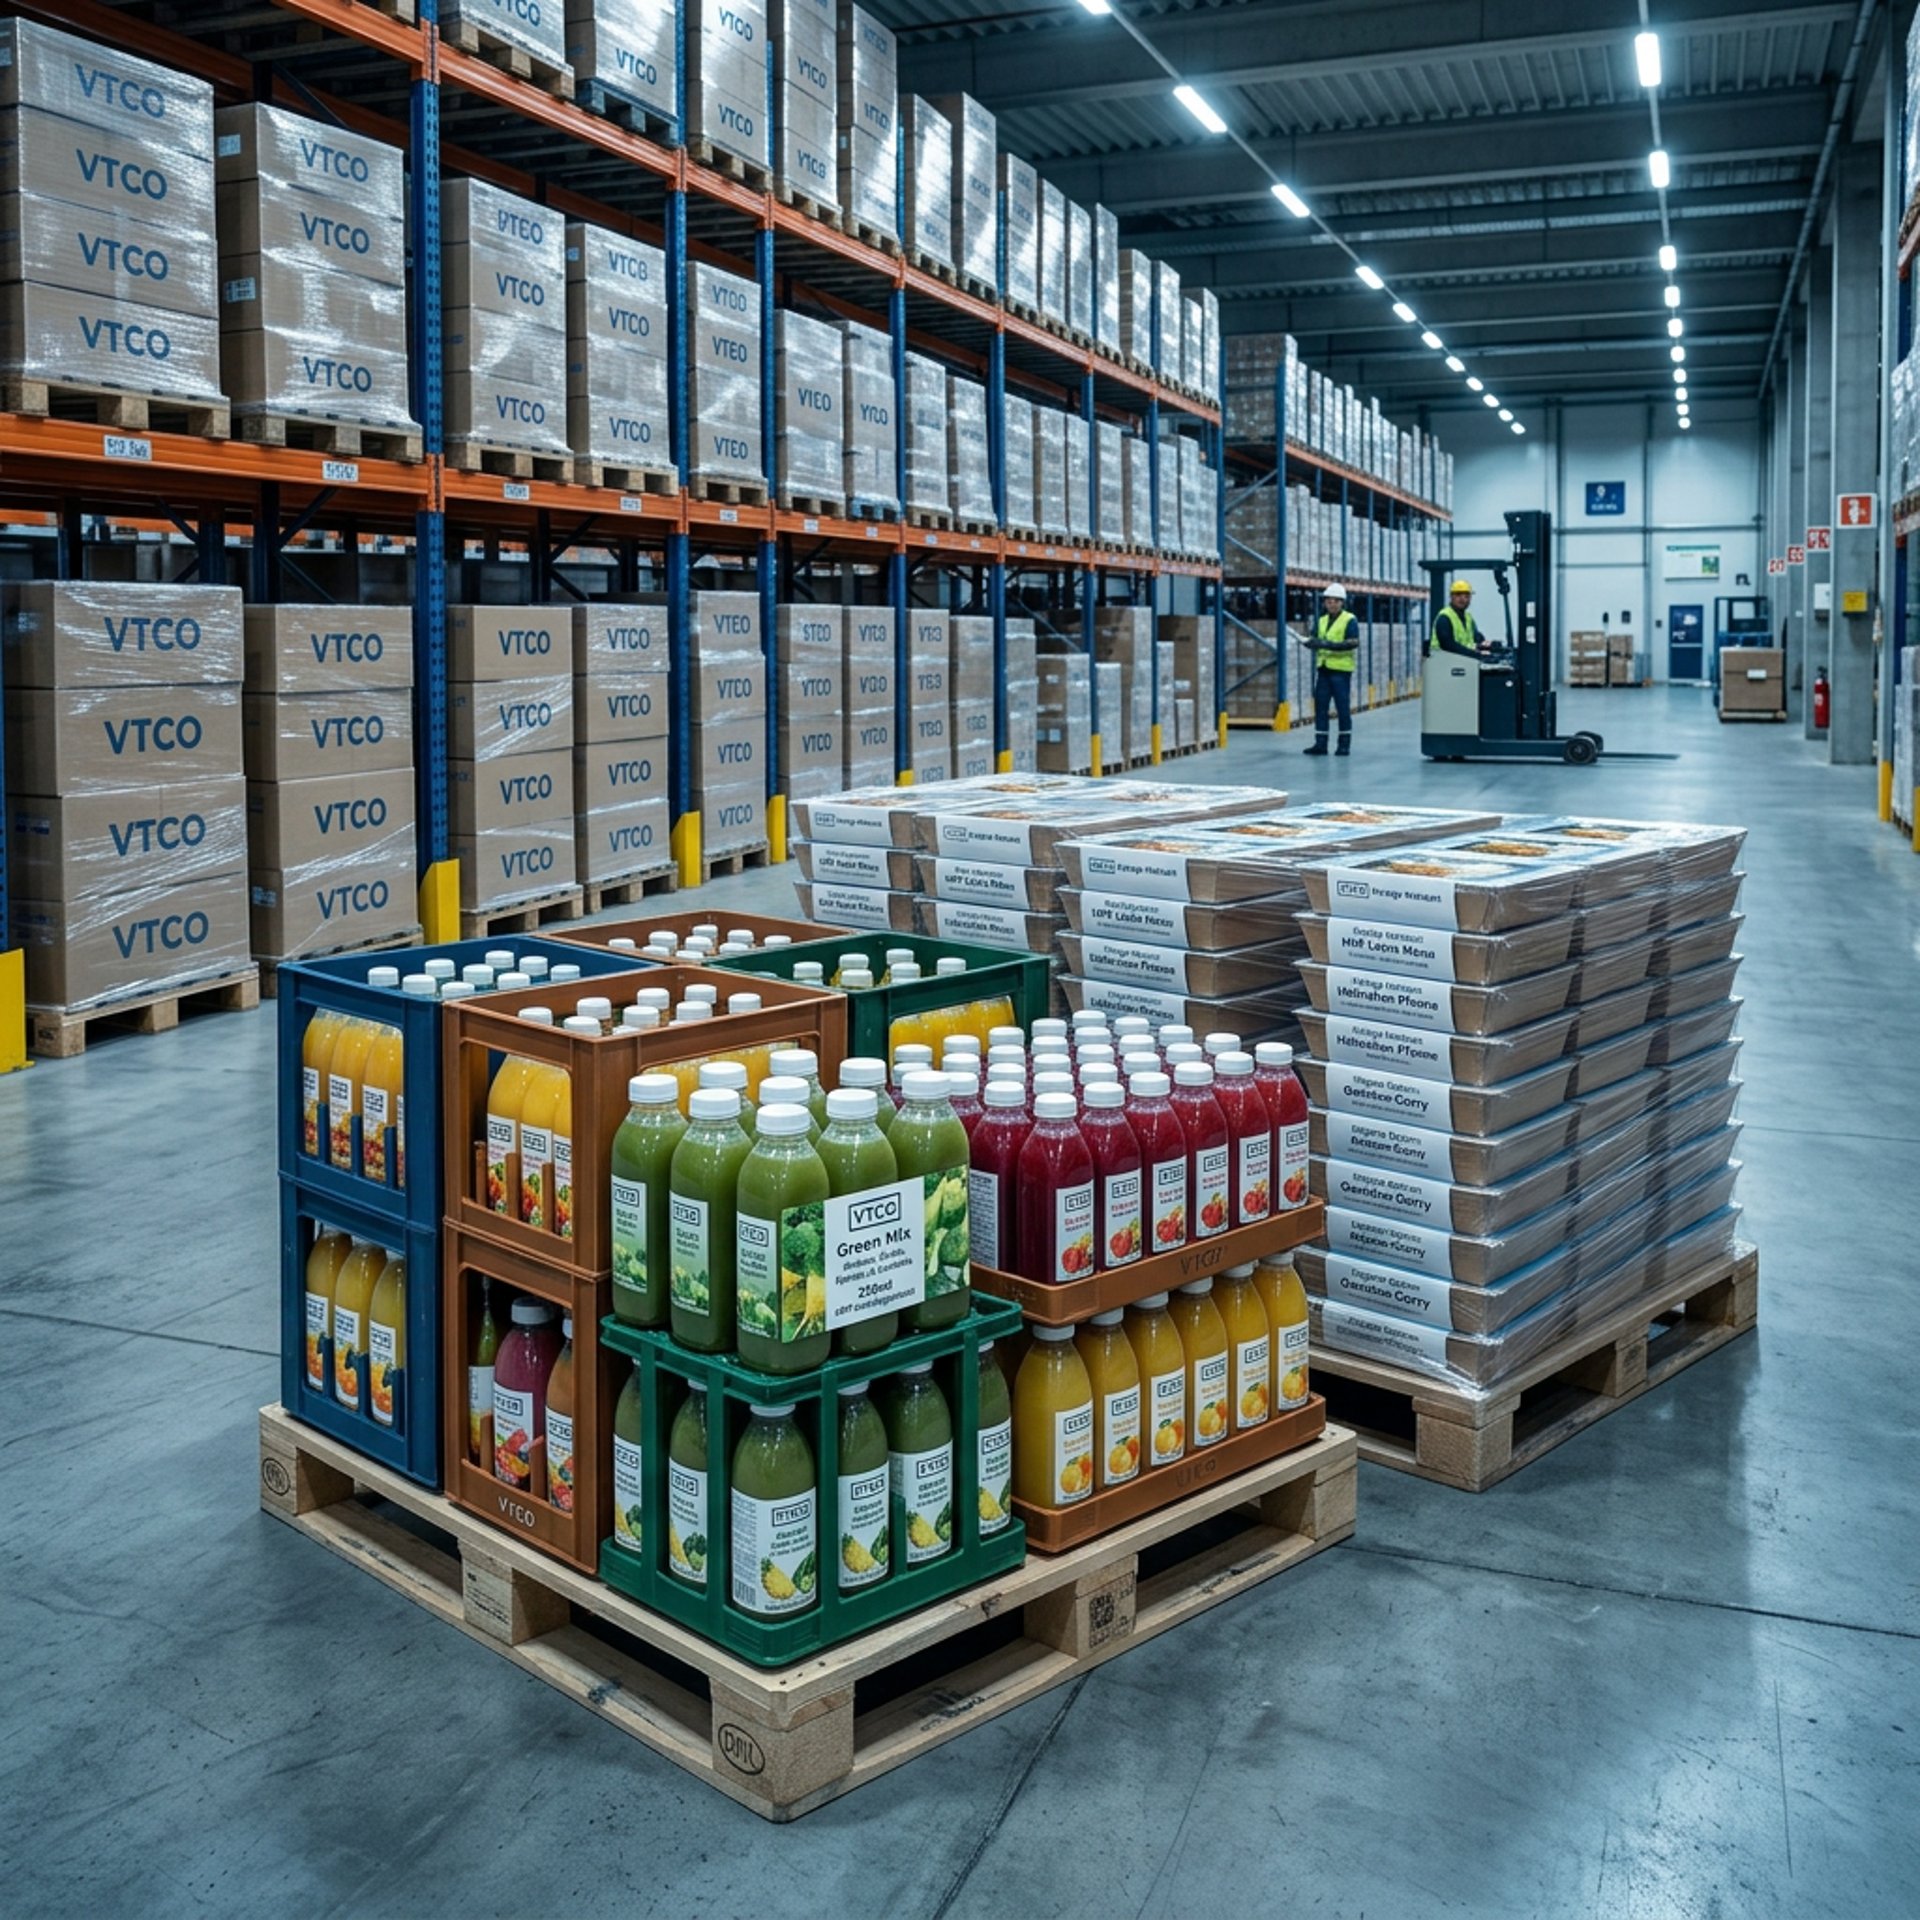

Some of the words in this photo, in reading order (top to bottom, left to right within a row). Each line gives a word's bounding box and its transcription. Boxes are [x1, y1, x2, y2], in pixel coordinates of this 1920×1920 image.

[75, 63, 166, 118] VTCO
[718, 103, 753, 137] VTCO
[76, 149, 168, 200] VTCO
[300, 138, 369, 182] VTCO
[301, 212, 370, 254] VTCO
[78, 232, 169, 280] VTCO
[497, 271, 545, 306] VTCO
[79, 316, 171, 360] VTCO
[608, 306, 650, 337] VTCO
[303, 356, 372, 392] VTCO
[497, 395, 545, 424] VTCO
[609, 417, 650, 443] VTCO
[104, 617, 201, 652] VTCO
[311, 633, 383, 663] VTCO
[499, 630, 551, 655] VTCO
[607, 628, 650, 650] VTCO
[500, 702, 551, 730] VTCO
[608, 694, 651, 718] VTCO
[104, 715, 202, 755] VTCO
[311, 716, 384, 749] VTCO
[718, 742, 752, 764] VTCO
[500, 774, 552, 805] VTCO
[608, 760, 651, 786] VTCO
[314, 798, 387, 834] VTCO
[109, 813, 206, 857] VTCO
[609, 825, 652, 852] VTCO
[502, 846, 553, 878] VTCO
[317, 880, 389, 920] VTCO
[112, 911, 209, 959] VTCO
[854, 1202, 897, 1224] VTCO
[837, 1237, 881, 1257] Green
